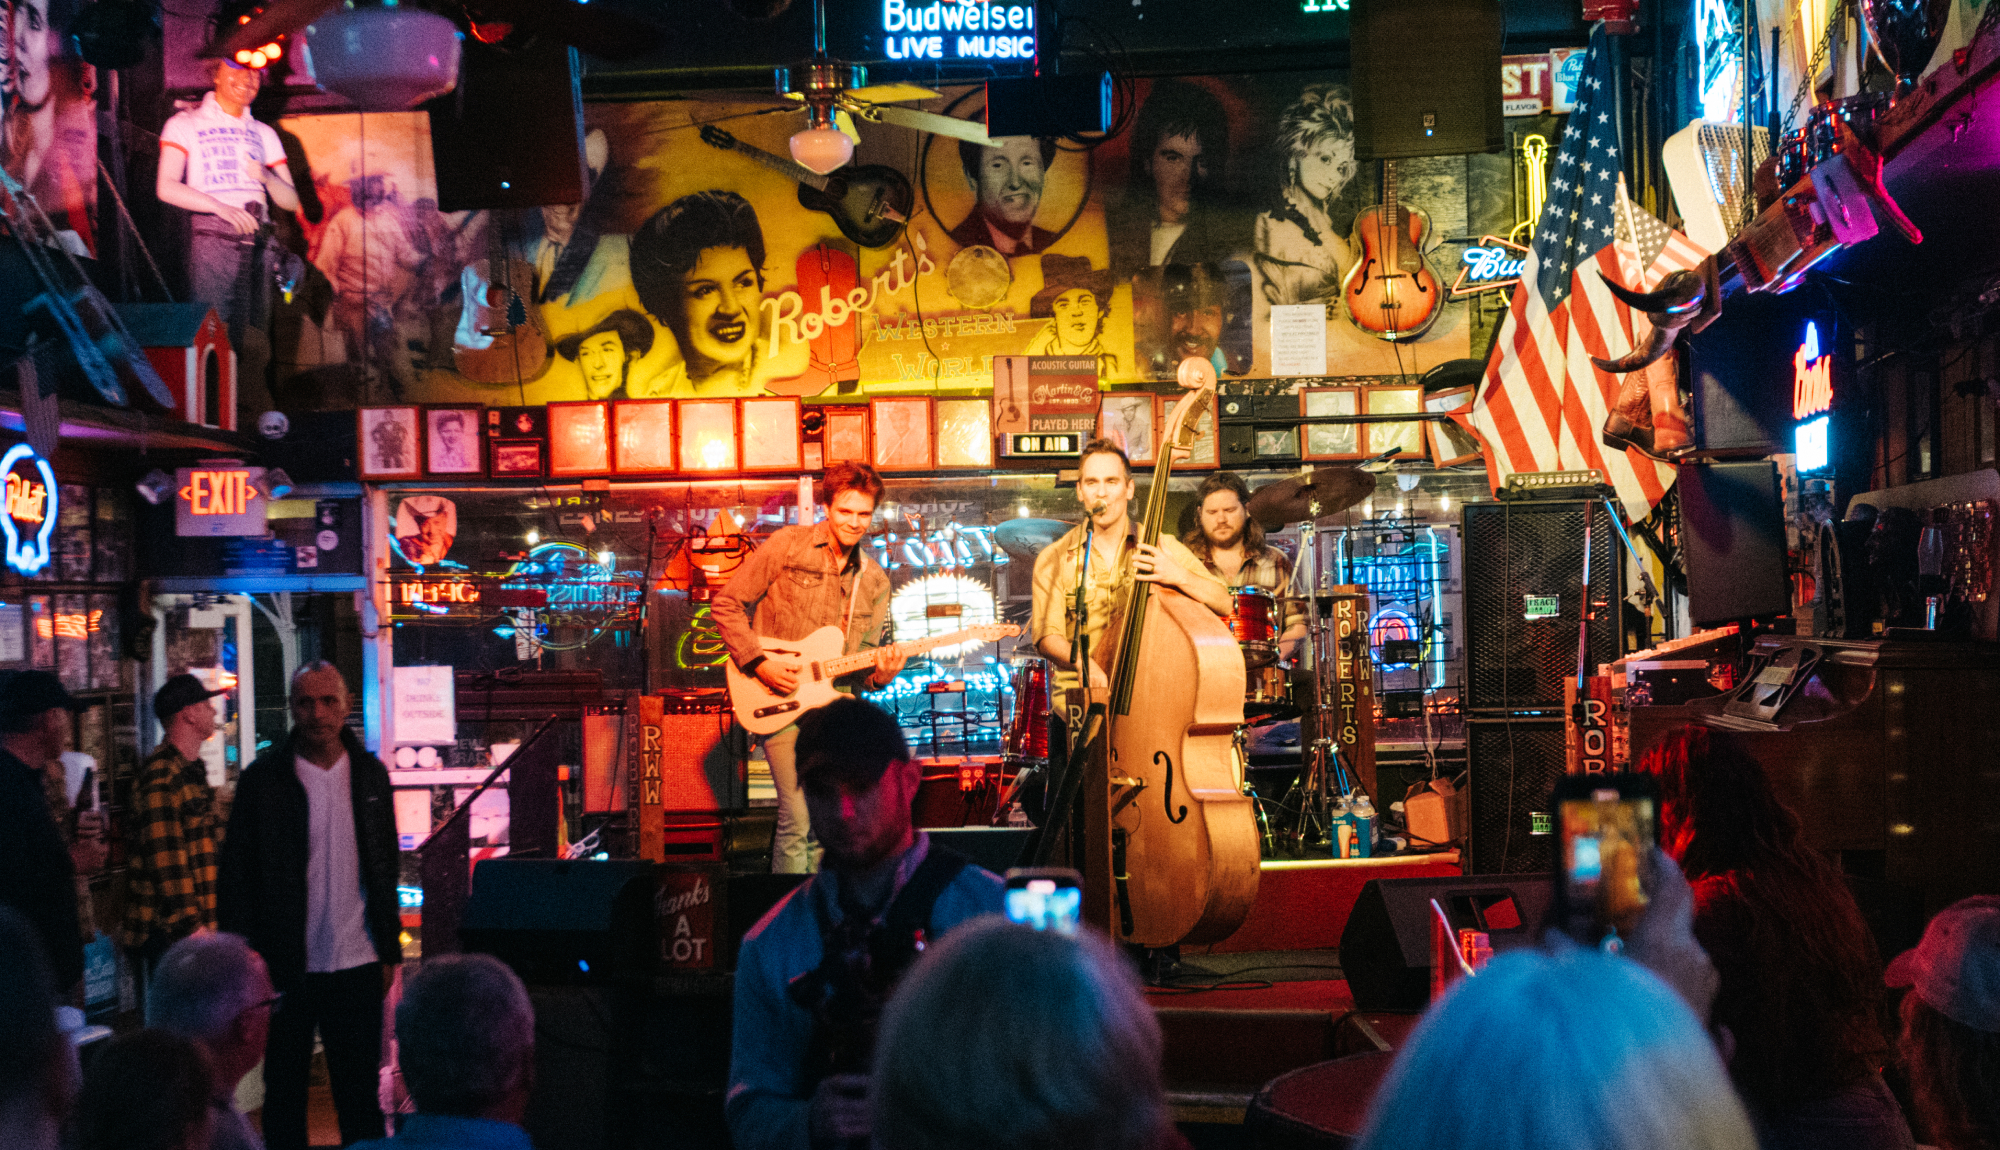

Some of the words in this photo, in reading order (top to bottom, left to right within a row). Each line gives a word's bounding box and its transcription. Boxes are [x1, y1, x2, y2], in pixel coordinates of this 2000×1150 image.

[886, 36, 943, 59] LIVE
[957, 36, 1034, 58] MUSIC
[1567, 58, 1584, 72] Pab
[1505, 103, 1538, 111] FLAVOR
[760, 231, 935, 359] Robert's
[872, 312, 1017, 342] WESTERN
[1031, 361, 1067, 370] ACOUSTIC
[1068, 360, 1095, 370] GUITAR
[1032, 419, 1069, 431] PLAYED
[1020, 436, 1041, 452] ON
[1044, 436, 1069, 451] AIR
[191, 471, 249, 515] EXIT
[675, 914, 692, 938] A
[661, 938, 707, 961] LOT
